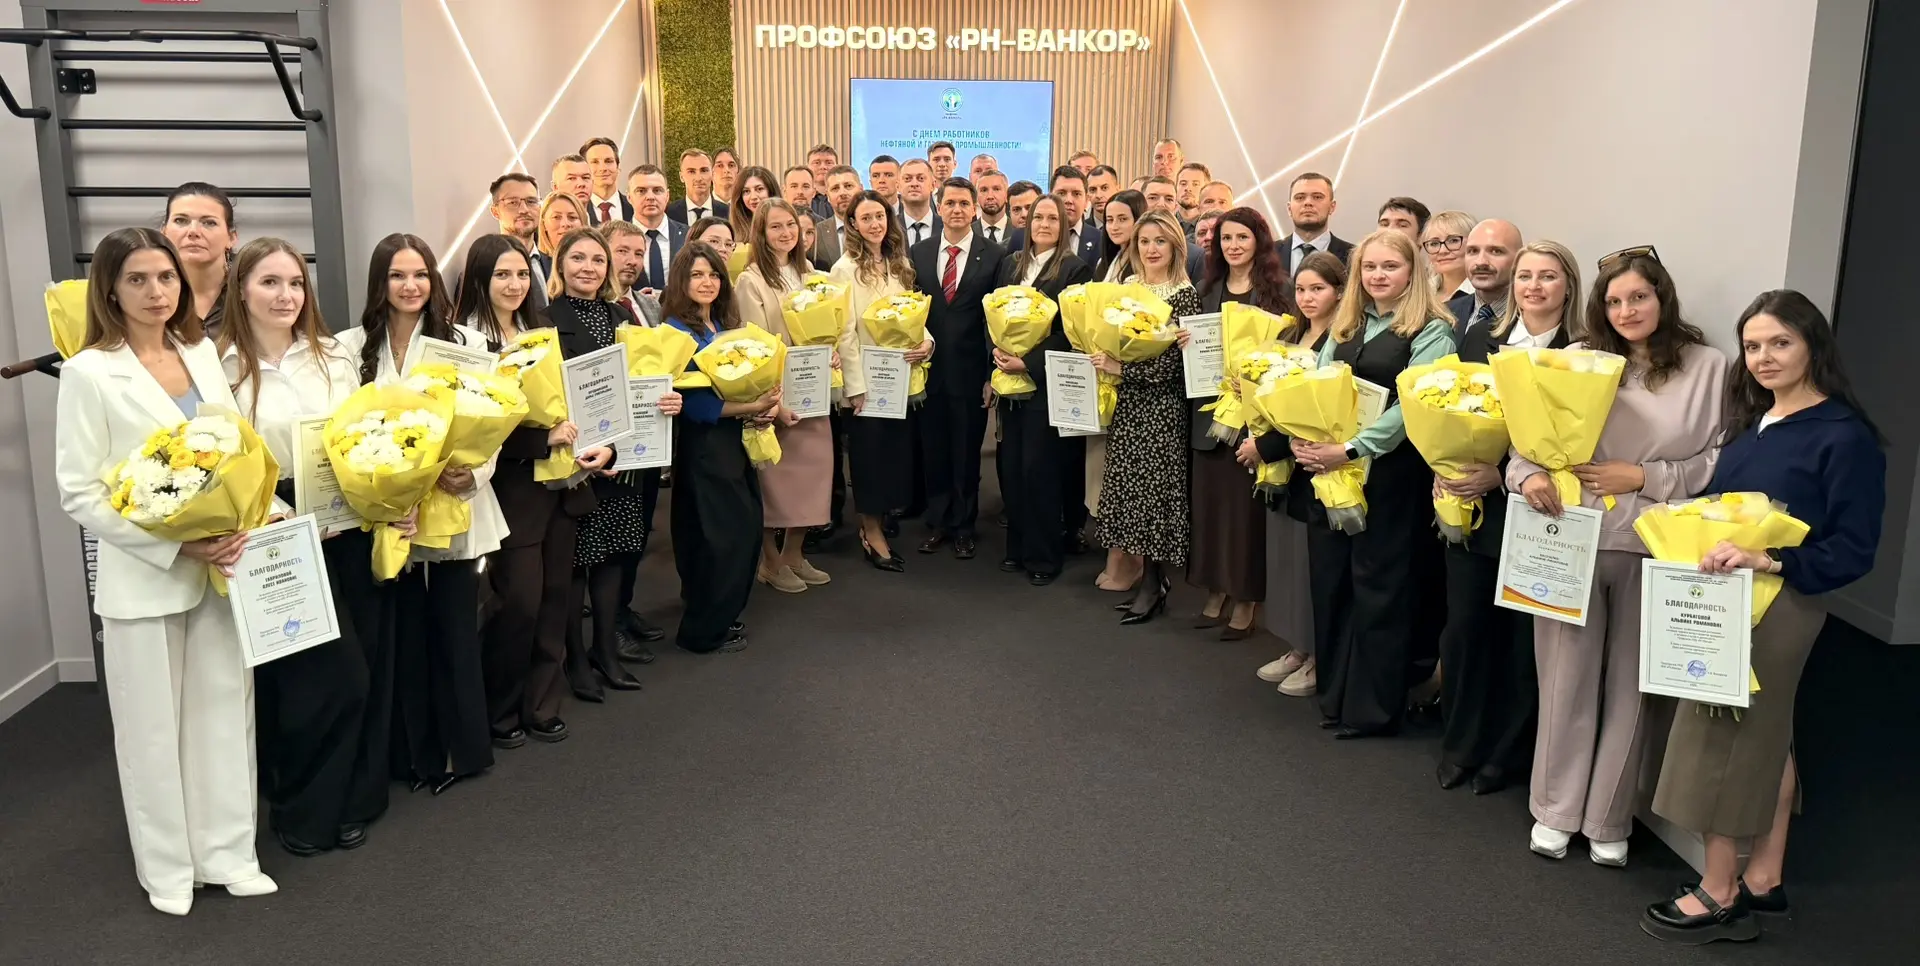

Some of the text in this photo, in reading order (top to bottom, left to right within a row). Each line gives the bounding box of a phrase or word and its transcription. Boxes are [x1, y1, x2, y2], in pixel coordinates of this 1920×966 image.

[755, 25, 937, 51] ПРОФСОЮЗ
[912, 130, 990, 139] С ДНЕМ РАБОТНИКОВ
[880, 139, 916, 149] НЕФТЯНОЙ
[918, 140, 923, 148] И
[955, 141, 1022, 149] ПРОМЫШЛЕННОСТИ!
[578, 374, 615, 391] БЛАГОДАРНОСТЬ
[1515, 532, 1586, 553] БЛАГОДАРНОСТЬ
[248, 556, 303, 578] БЛАГОДАРНОСТЬ
[1665, 599, 1727, 613] БЛАГОДАРНОСТЬ
